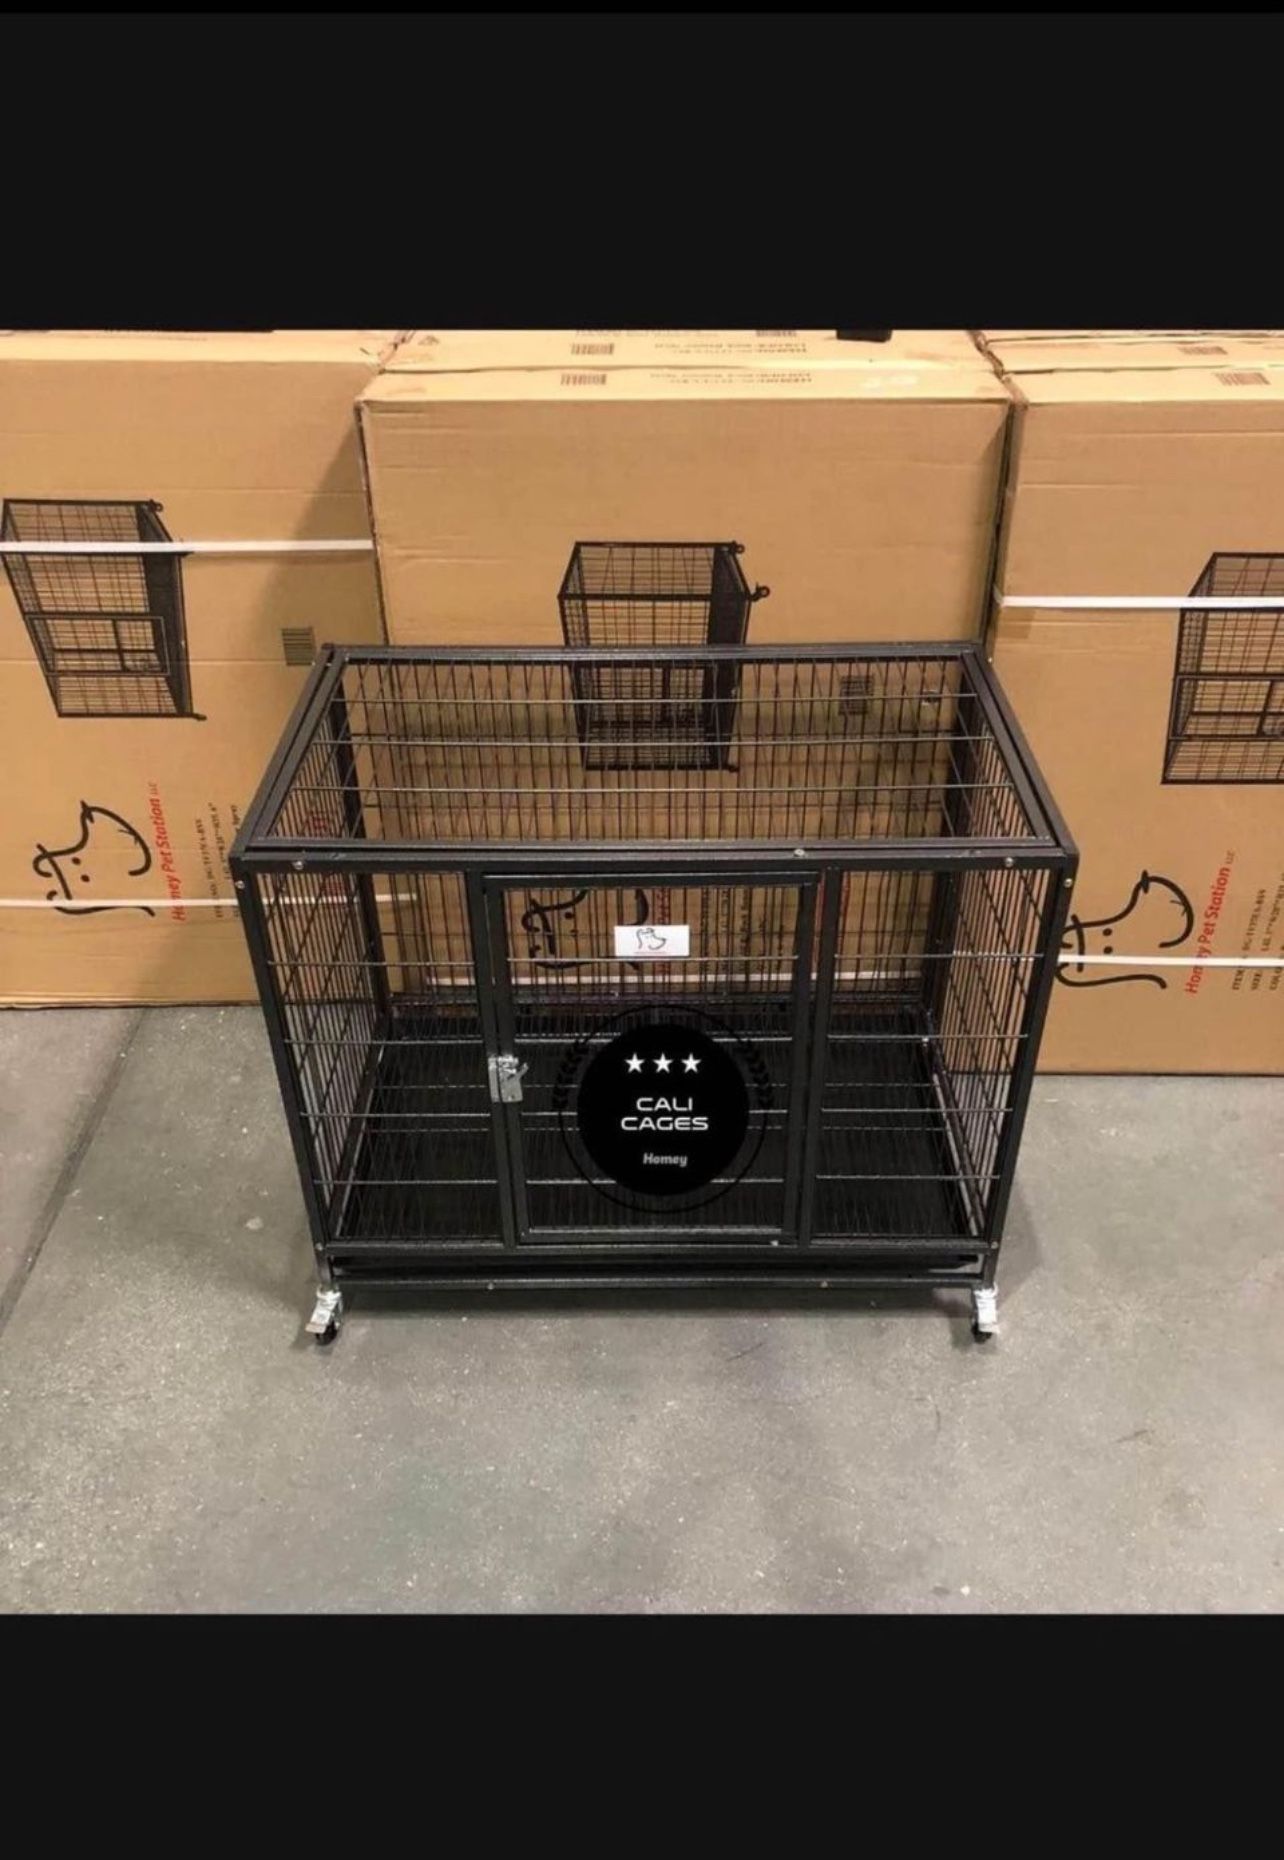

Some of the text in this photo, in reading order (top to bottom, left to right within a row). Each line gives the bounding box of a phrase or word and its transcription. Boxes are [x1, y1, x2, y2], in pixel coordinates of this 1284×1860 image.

[149, 798, 171, 848] Station
[160, 850, 175, 872] Pet
[1204, 866, 1231, 919] Station
[1197, 921, 1217, 945] Pet
